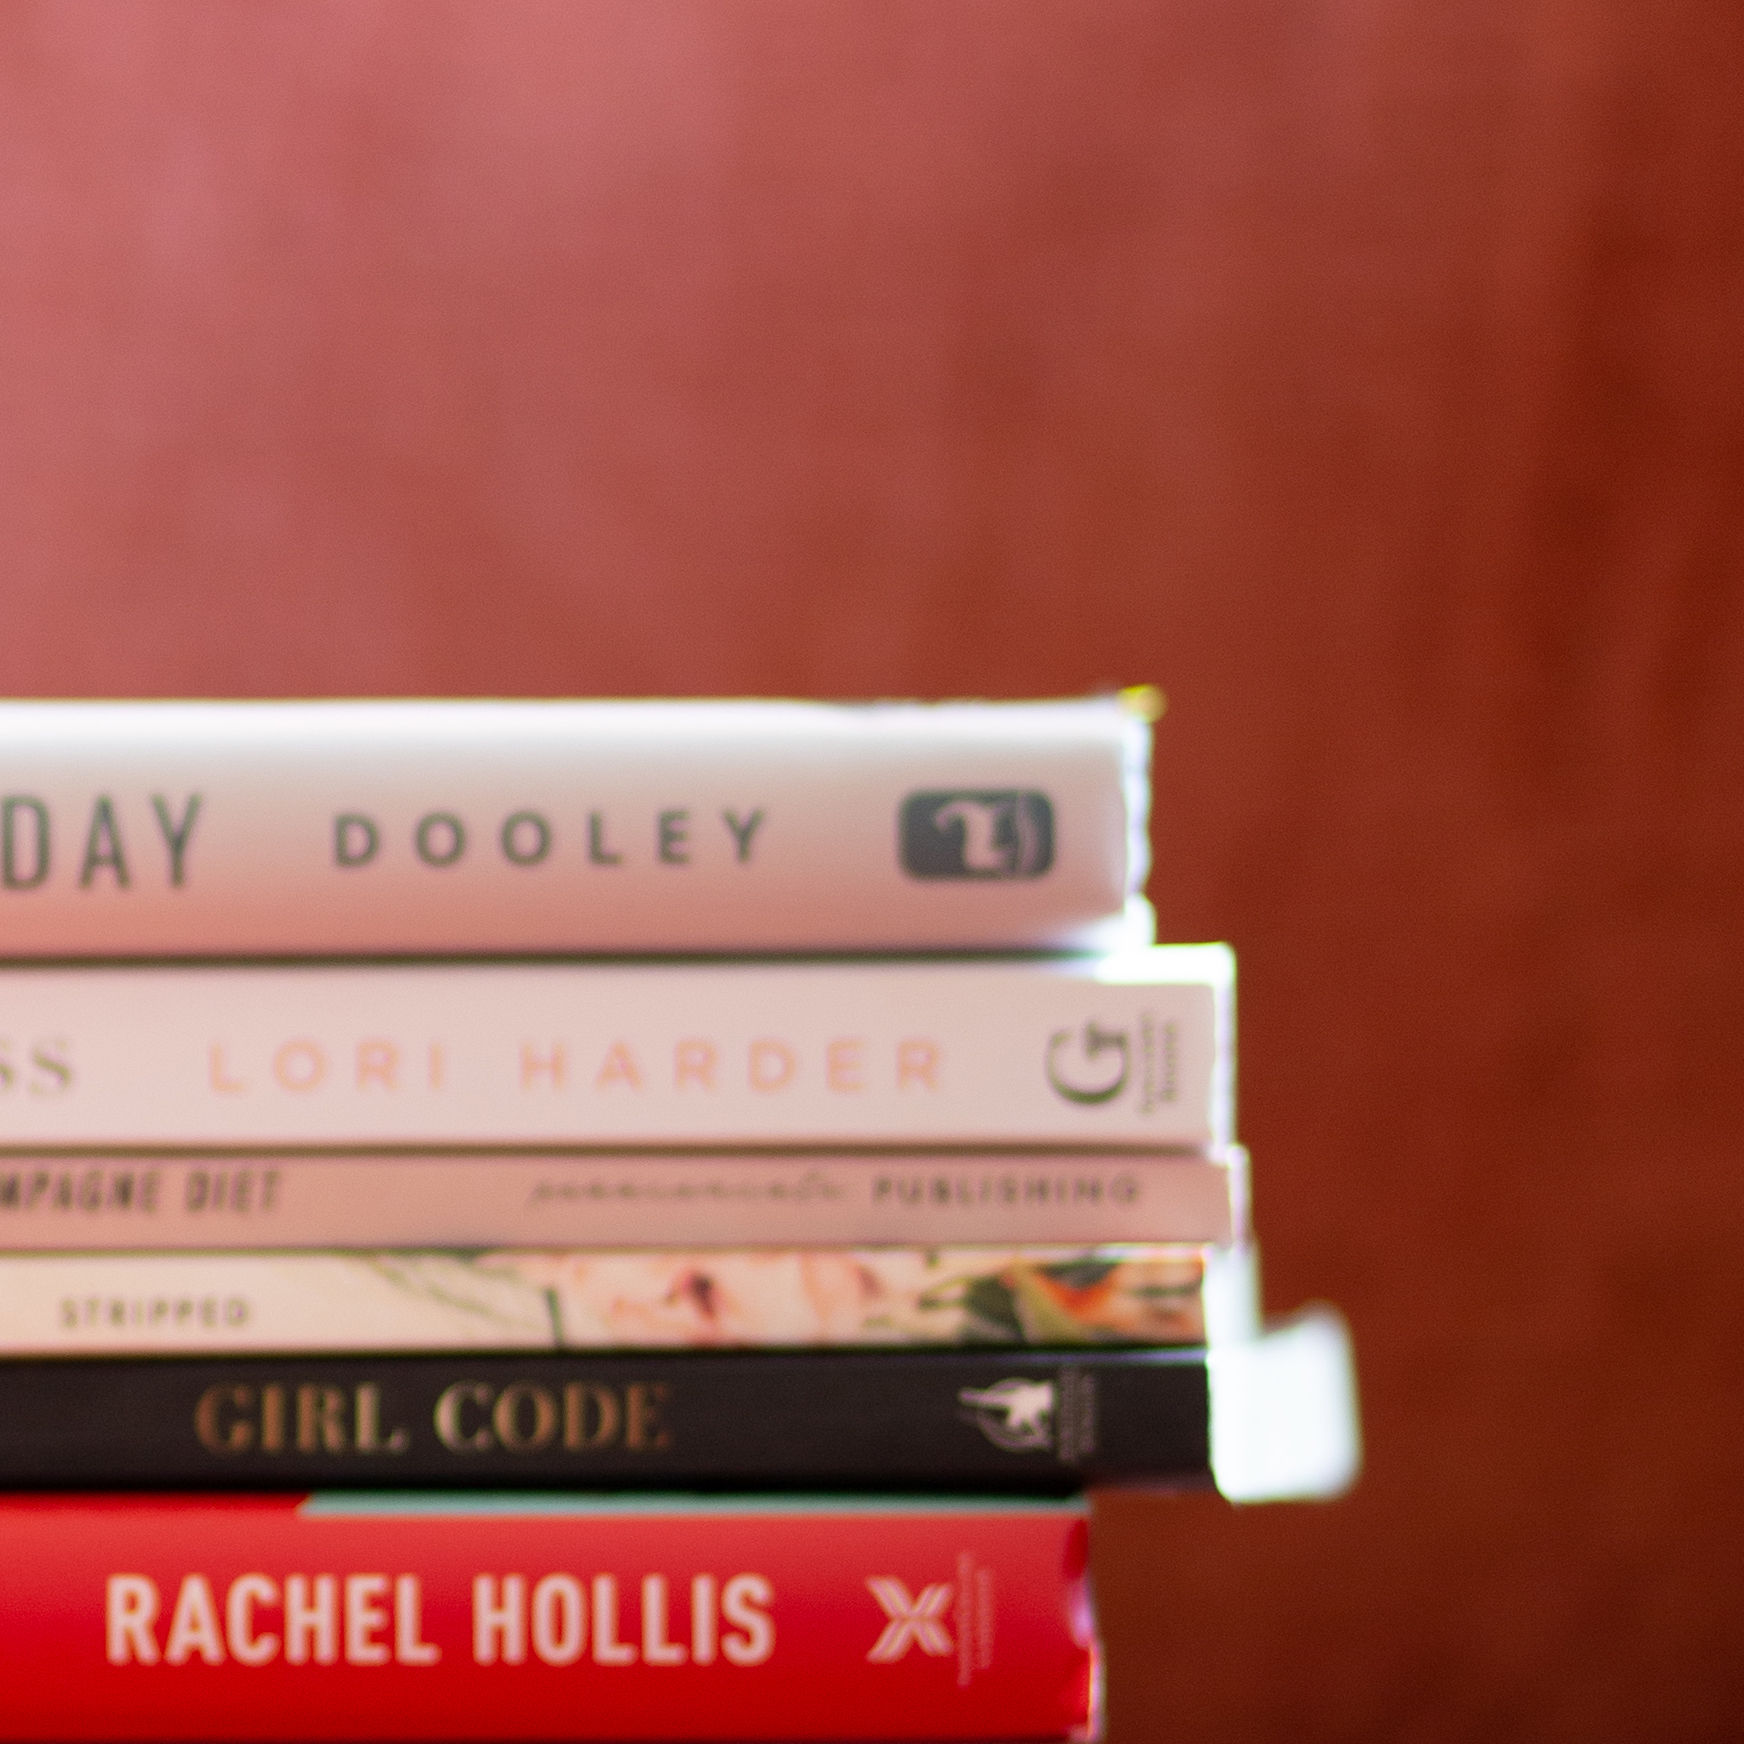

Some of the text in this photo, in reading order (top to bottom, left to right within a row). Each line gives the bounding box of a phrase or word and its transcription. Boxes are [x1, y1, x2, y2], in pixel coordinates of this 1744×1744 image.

[333, 809, 766, 867] DOOLEY
[209, 1041, 445, 1093] LORI
[518, 1040, 942, 1092] HARDER
[185, 1168, 284, 1212] DIET
[871, 1174, 1143, 1209] PUBLISHING
[61, 1296, 252, 1329] STRIPPED
[193, 1384, 411, 1453] GIRL
[434, 1382, 672, 1452] CODE
[104, 1572, 441, 1666] RACHEL
[471, 1571, 776, 1666] HOLLIS
